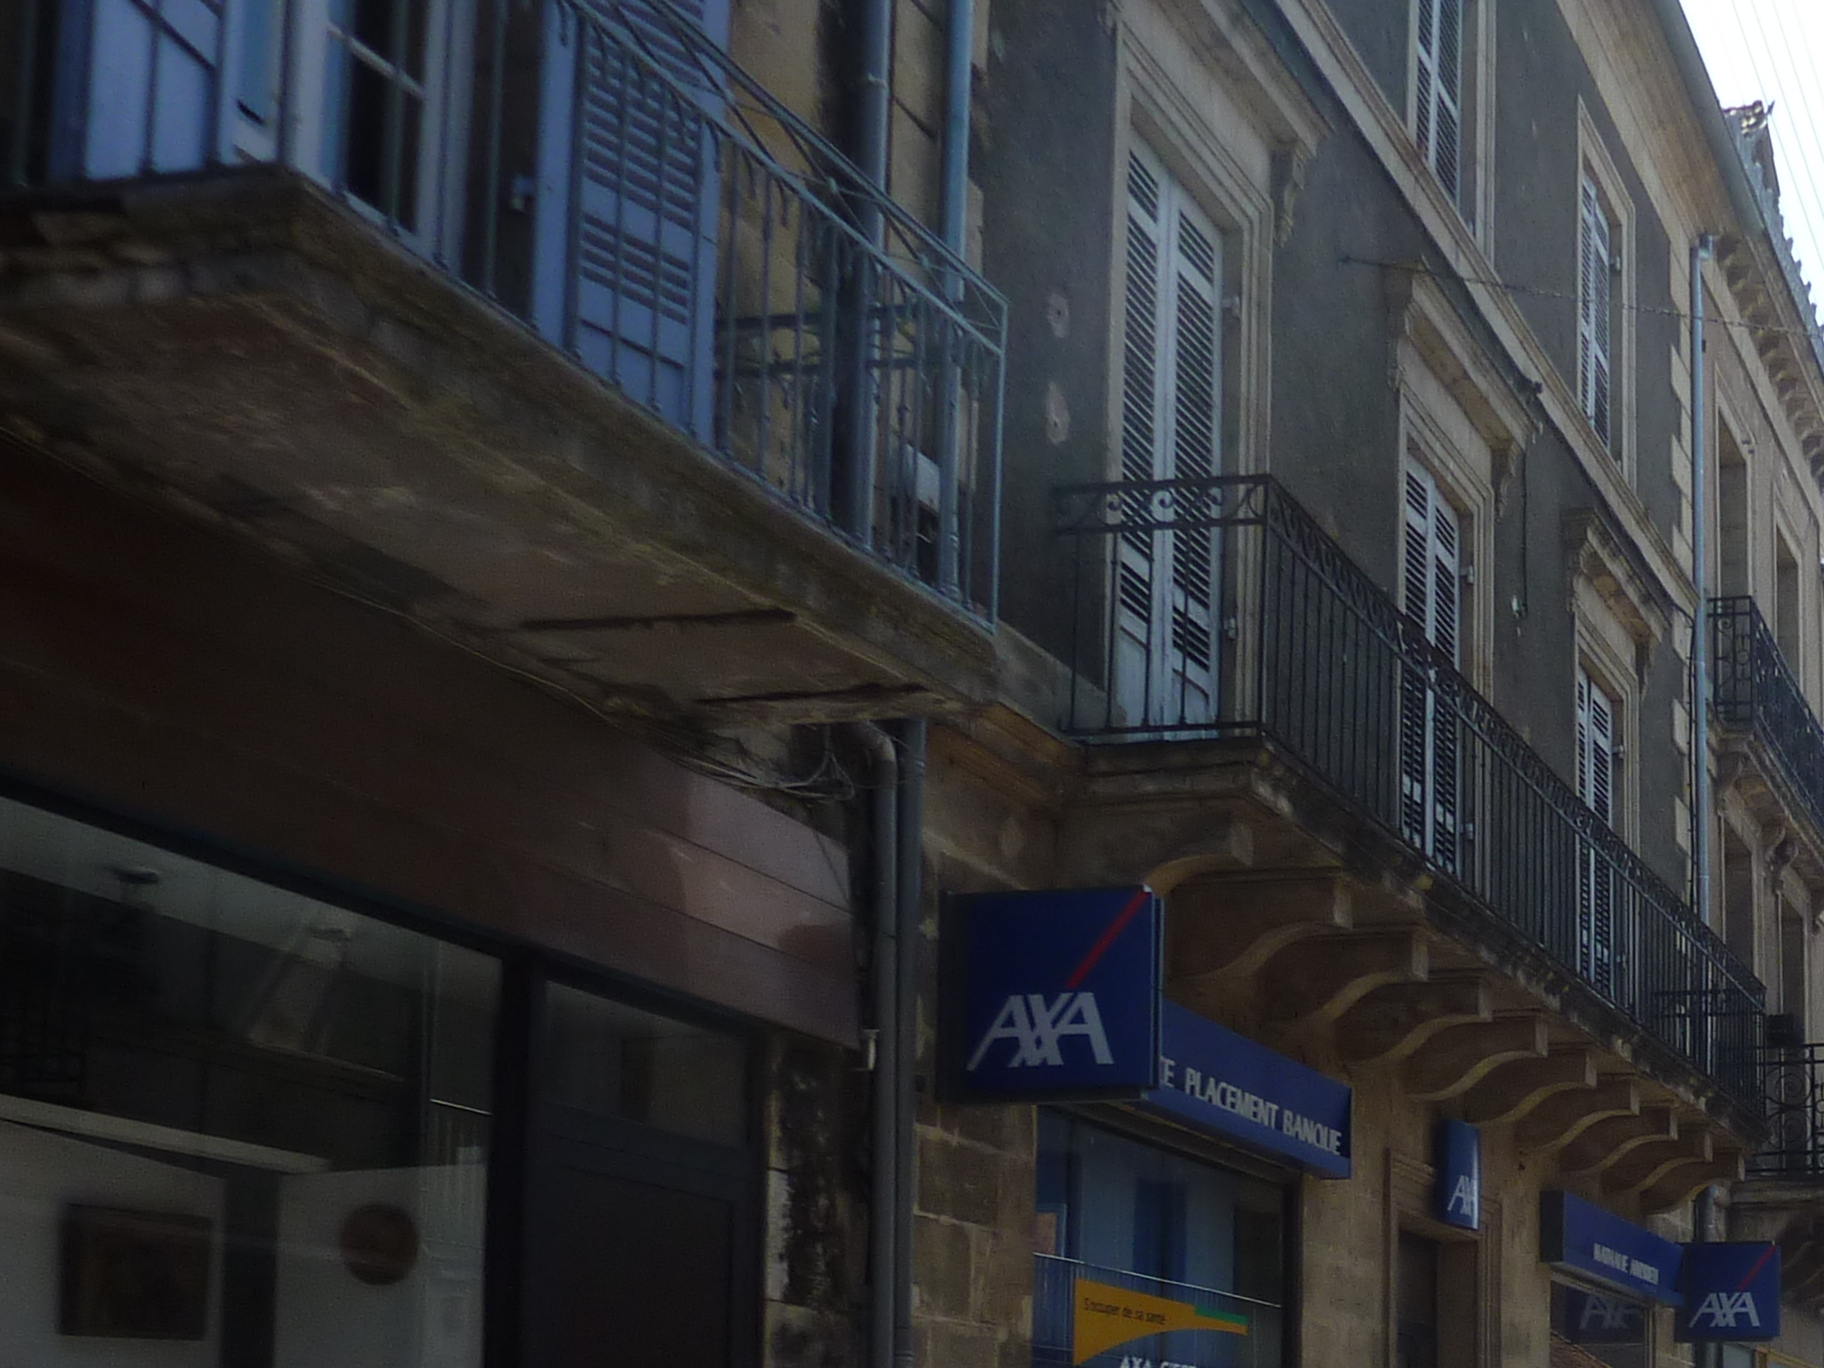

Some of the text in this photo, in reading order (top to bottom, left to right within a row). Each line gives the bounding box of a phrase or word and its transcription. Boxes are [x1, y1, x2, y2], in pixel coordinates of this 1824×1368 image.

[965, 991, 1115, 1071] AXA
[1184, 1066, 1279, 1130] PLACEMENT
[1282, 1108, 1342, 1156] BANQUE
[1688, 1291, 1760, 1328] AXA
